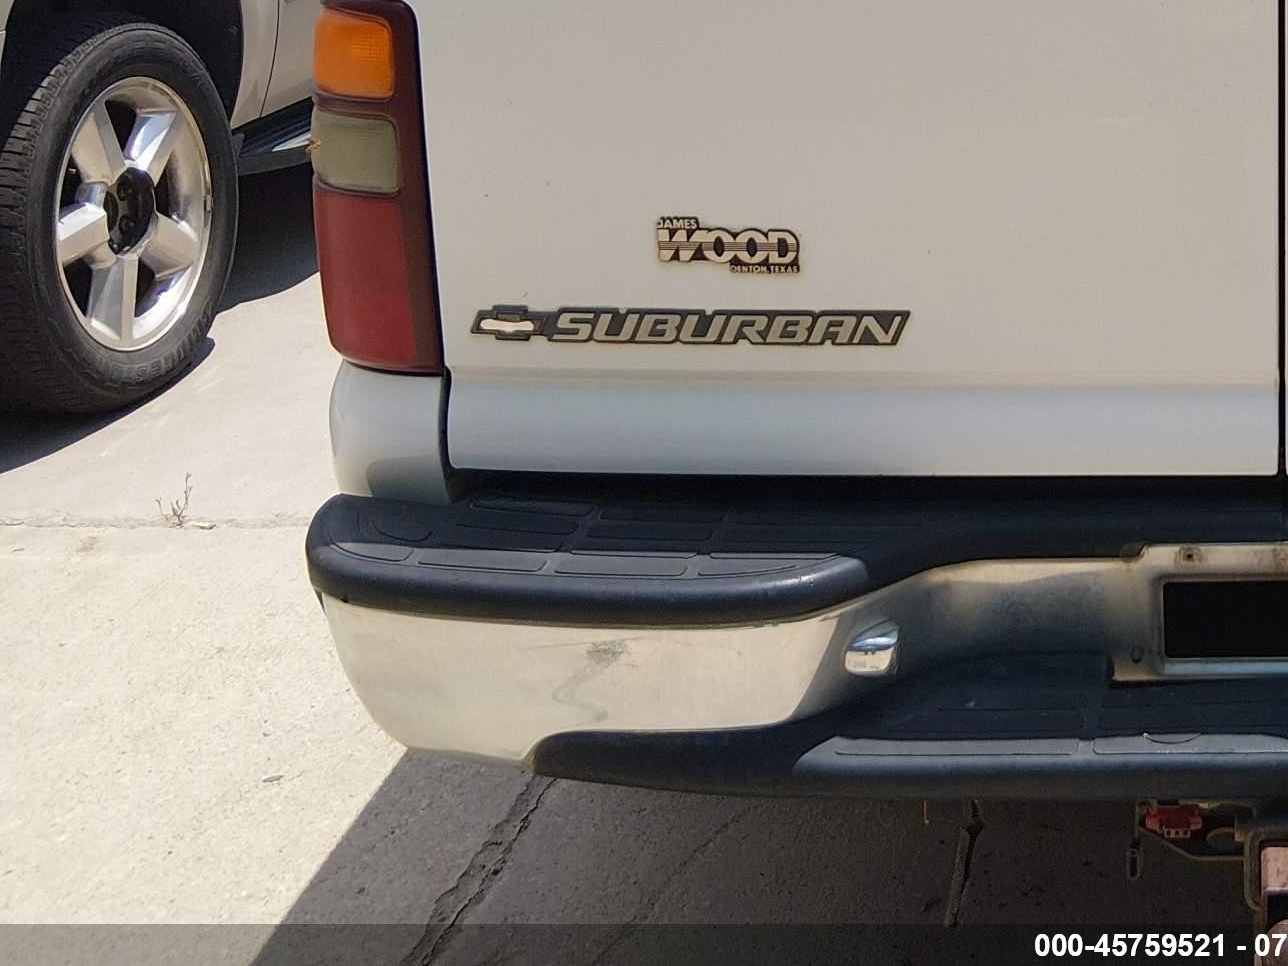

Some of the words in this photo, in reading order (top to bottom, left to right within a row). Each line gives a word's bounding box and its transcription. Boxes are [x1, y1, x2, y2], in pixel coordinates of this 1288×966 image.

[657, 218, 698, 230] JAMES
[658, 228, 798, 265] WOOD
[770, 265, 798, 274] TEXAS
[551, 309, 905, 345] SUBURBAN
